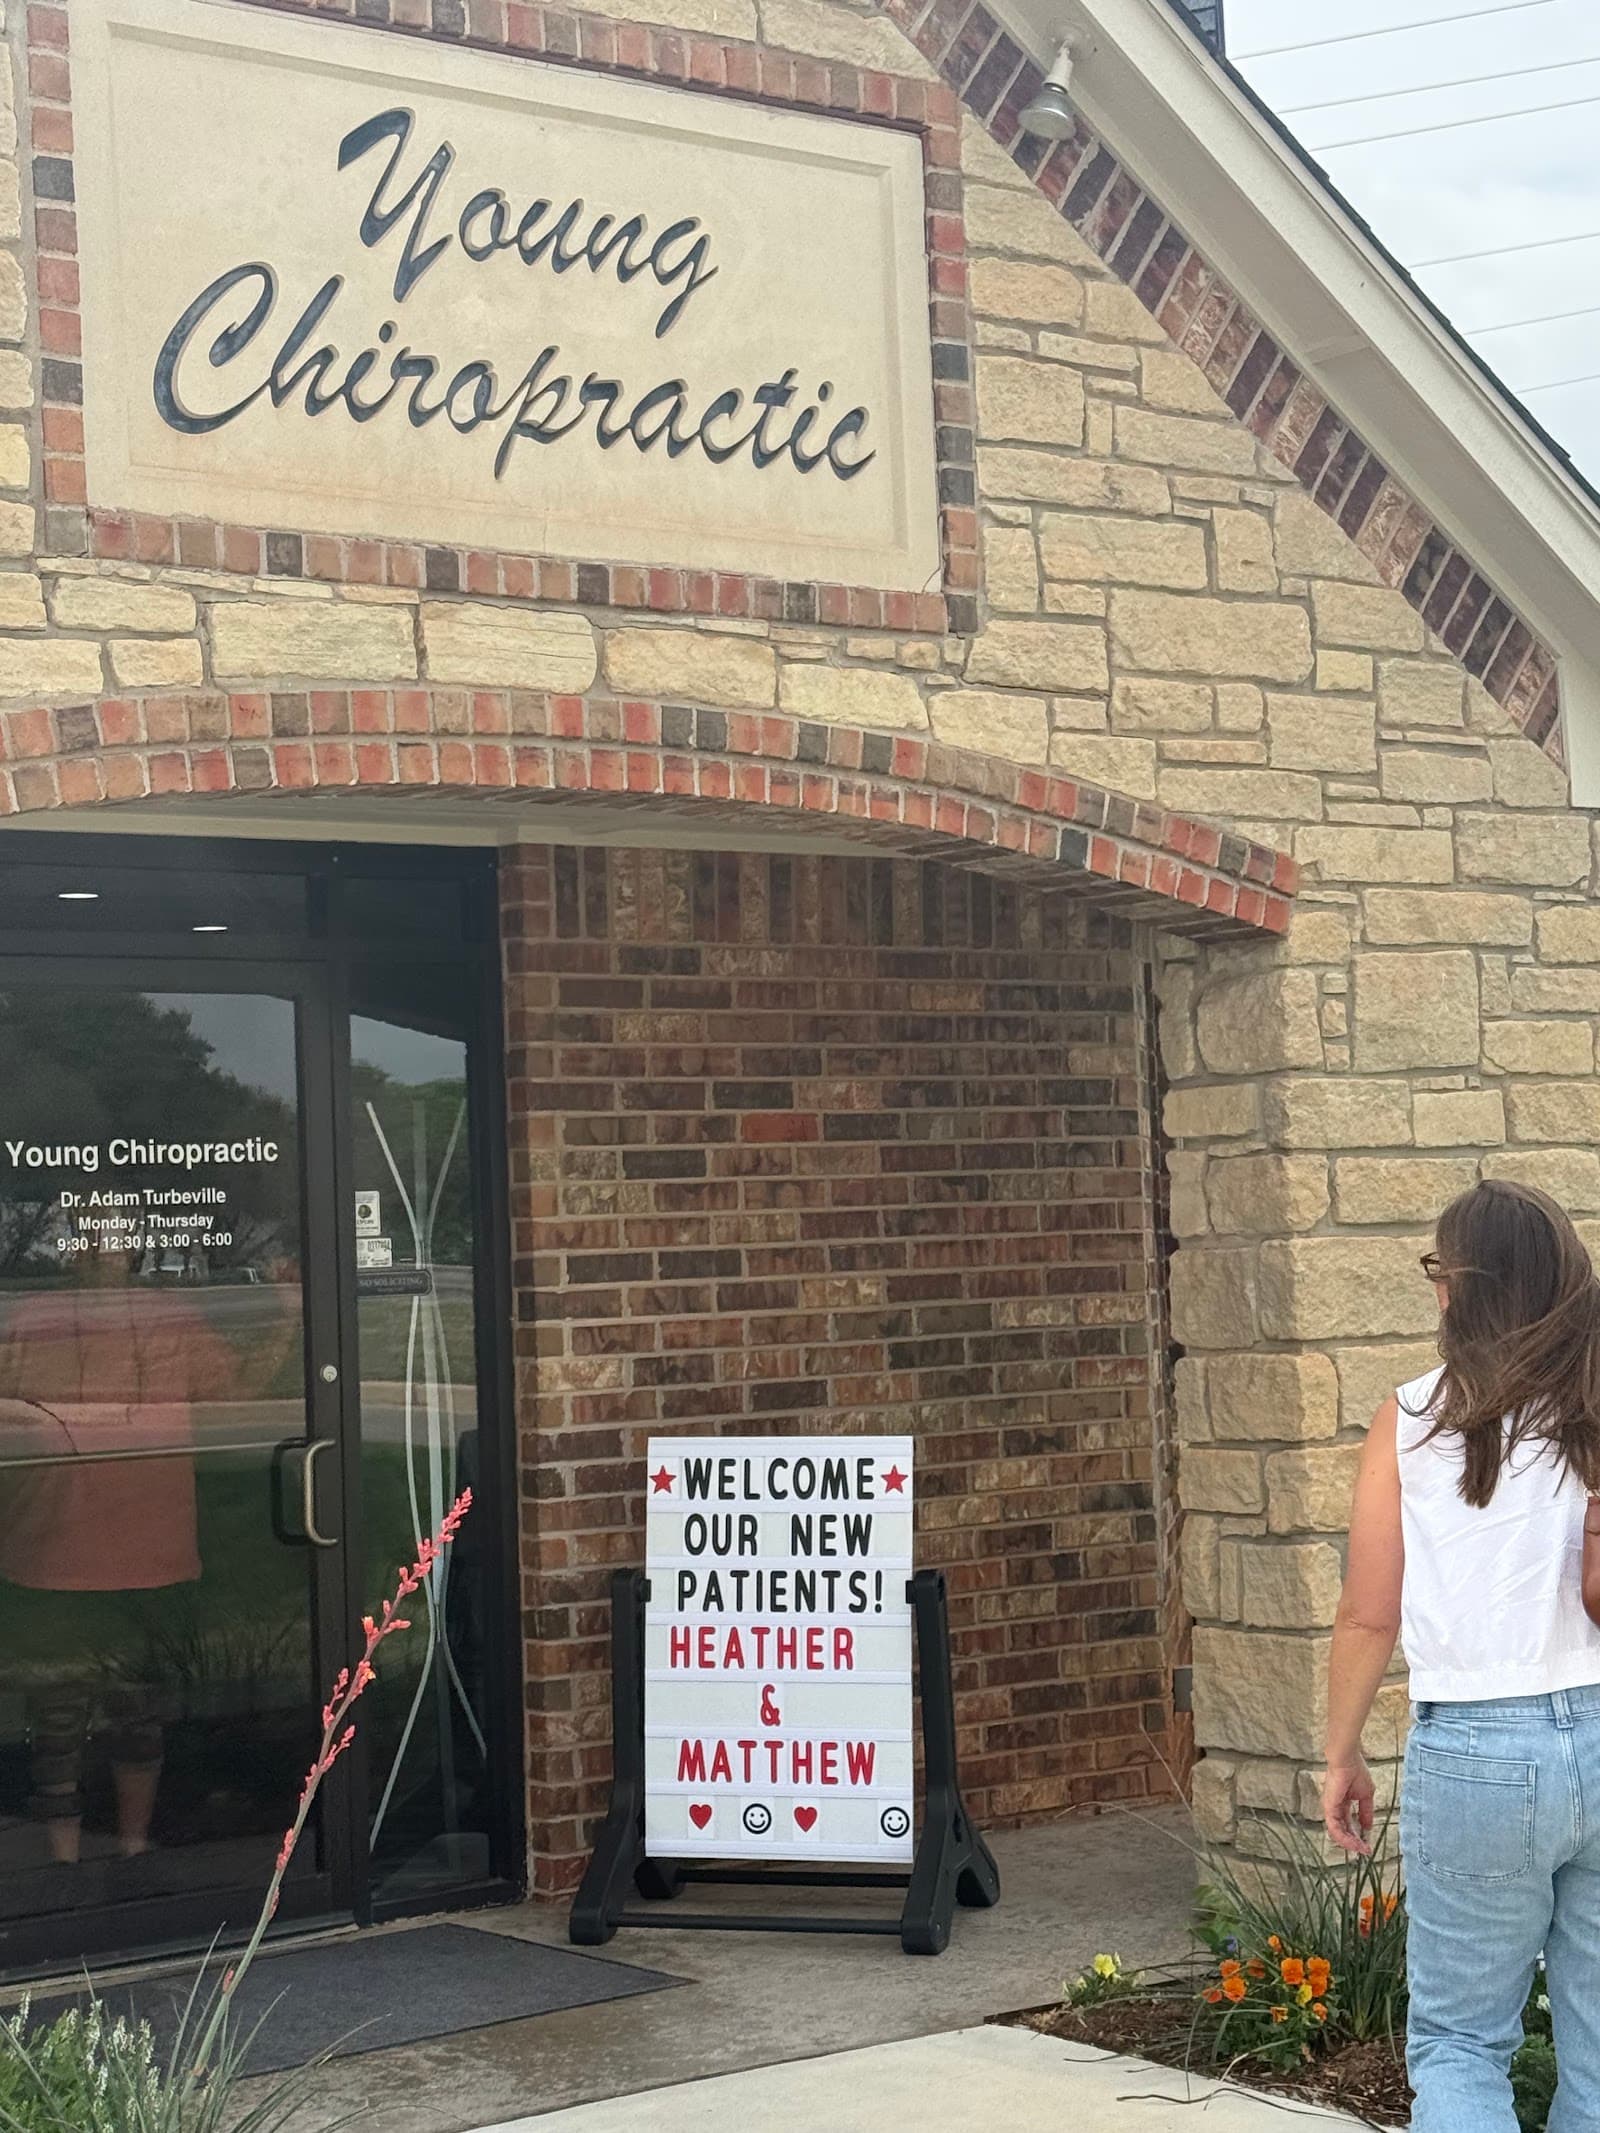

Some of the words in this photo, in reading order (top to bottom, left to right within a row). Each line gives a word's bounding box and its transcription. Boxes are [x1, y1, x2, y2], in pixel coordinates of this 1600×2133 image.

[338, 106, 719, 338] Young
[153, 261, 876, 480] Chiropractic
[5, 1140, 99, 1172] Young
[108, 1137, 279, 1170] Chiropractic
[60, 1191, 86, 1208] Dr.
[89, 1190, 139, 1207] Adam
[143, 1187, 226, 1206] Turbeville
[57, 1237, 89, 1251] 9:30
[103, 1236, 141, 1250] 12:30
[145, 1235, 156, 1249] &
[159, 1233, 190, 1248] 3:00
[202, 1232, 233, 1247] 6:00
[78, 1216, 136, 1232] Monday
[147, 1213, 214, 1230] Thursday
[684, 1457, 875, 1500] WELCOME
[684, 1513, 758, 1556] OUR
[791, 1513, 873, 1556] NEW
[678, 1570, 882, 1613] PATIENTS!
[670, 1626, 854, 1670] HEATHER
[760, 1684, 781, 1727] &
[677, 1739, 876, 1785] MATTHEW
